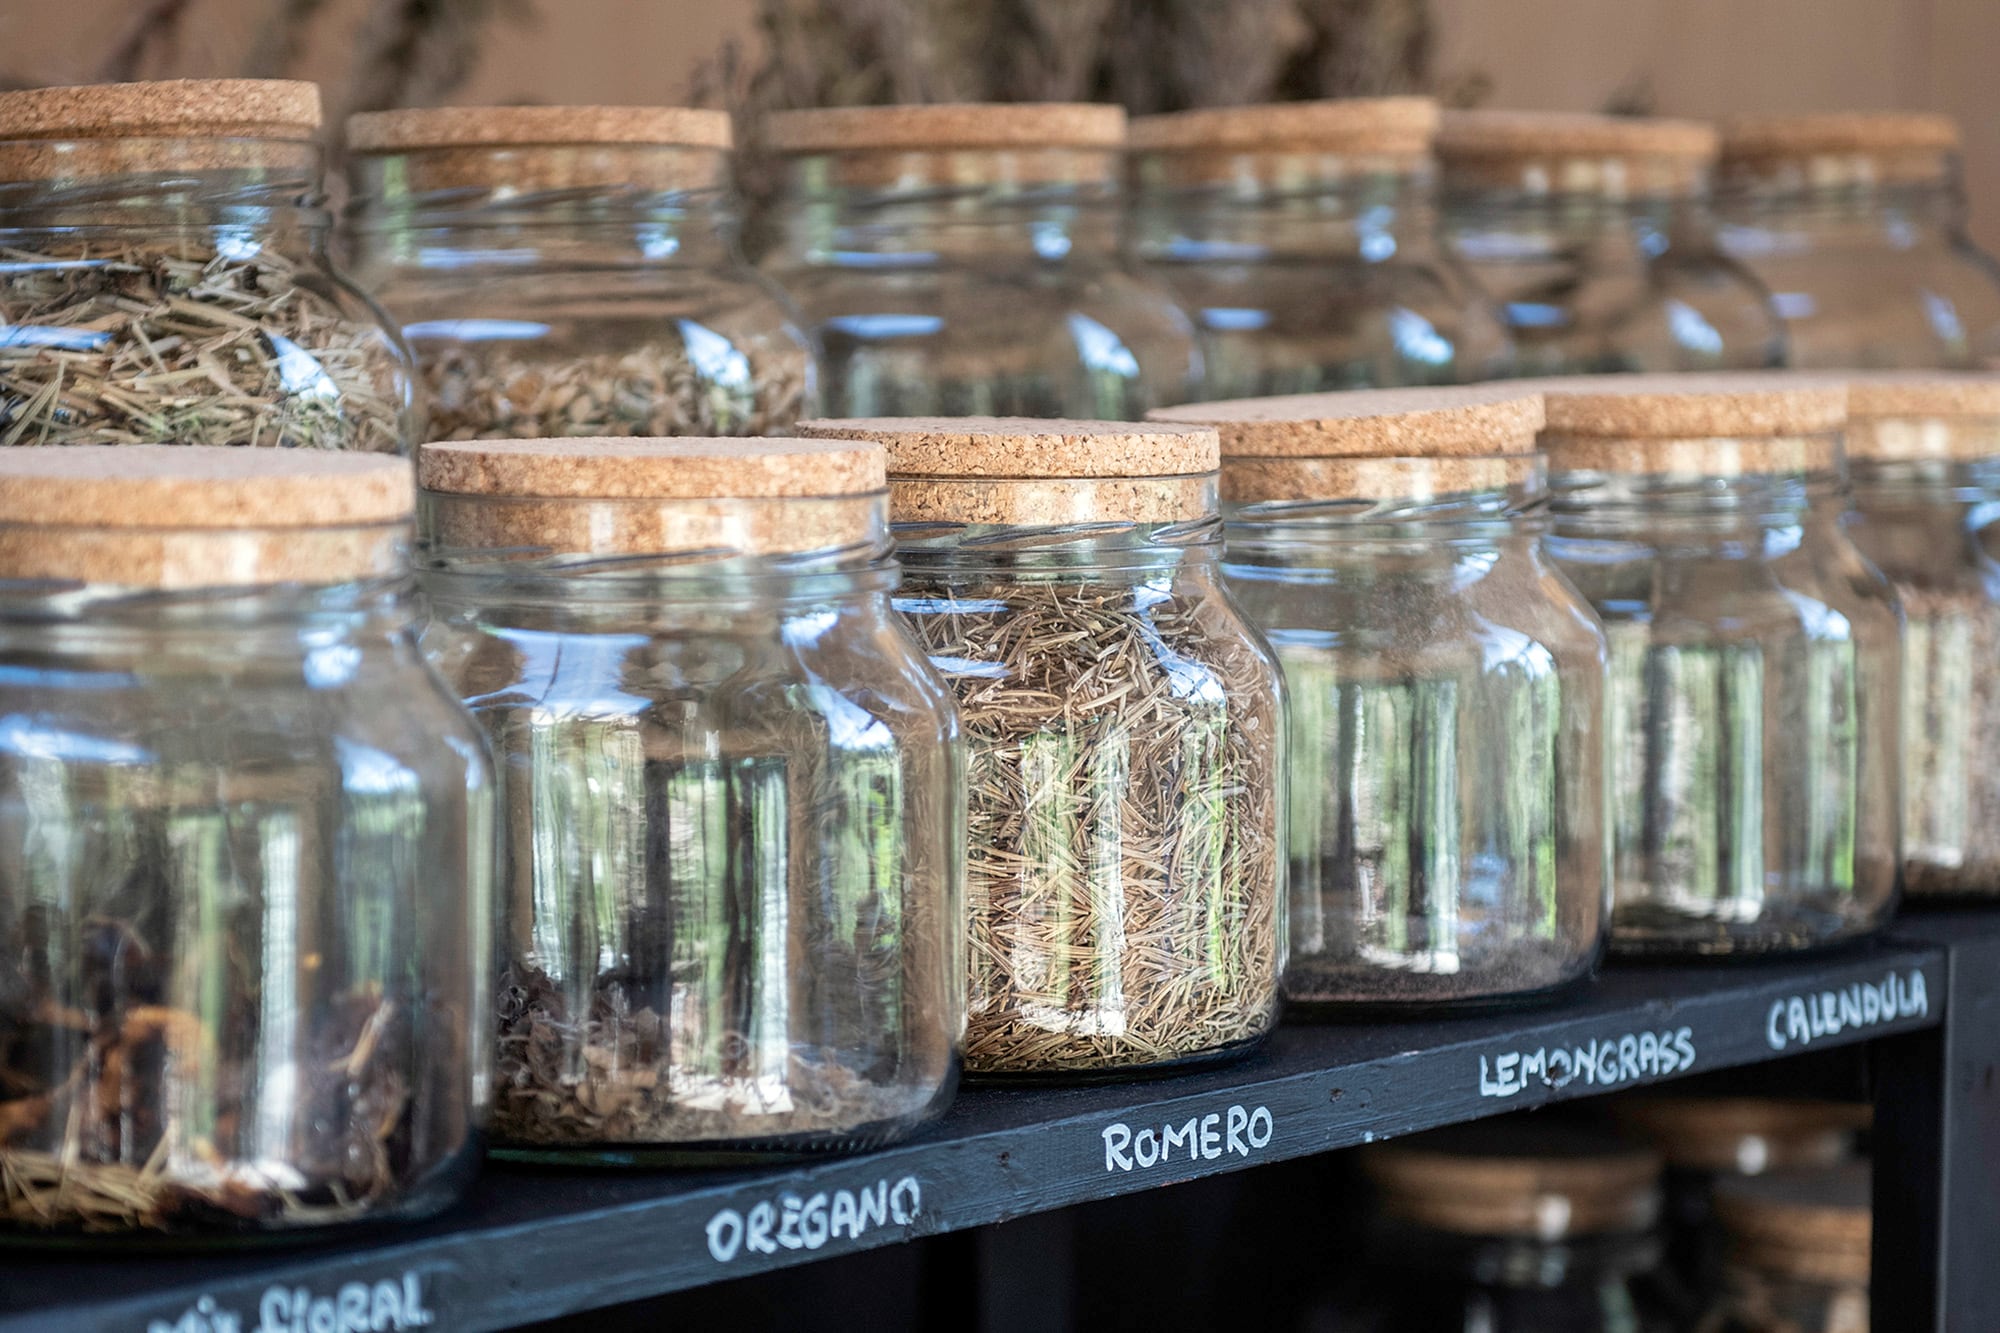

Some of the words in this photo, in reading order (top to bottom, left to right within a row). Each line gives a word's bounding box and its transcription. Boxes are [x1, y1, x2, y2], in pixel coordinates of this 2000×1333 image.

[1767, 970, 1928, 1049] CALENDULA
[1479, 1026, 1696, 1097] LEMONGRASS
[1101, 1104, 1273, 1172] ROMERO
[705, 1176, 921, 1262] OREGANO
